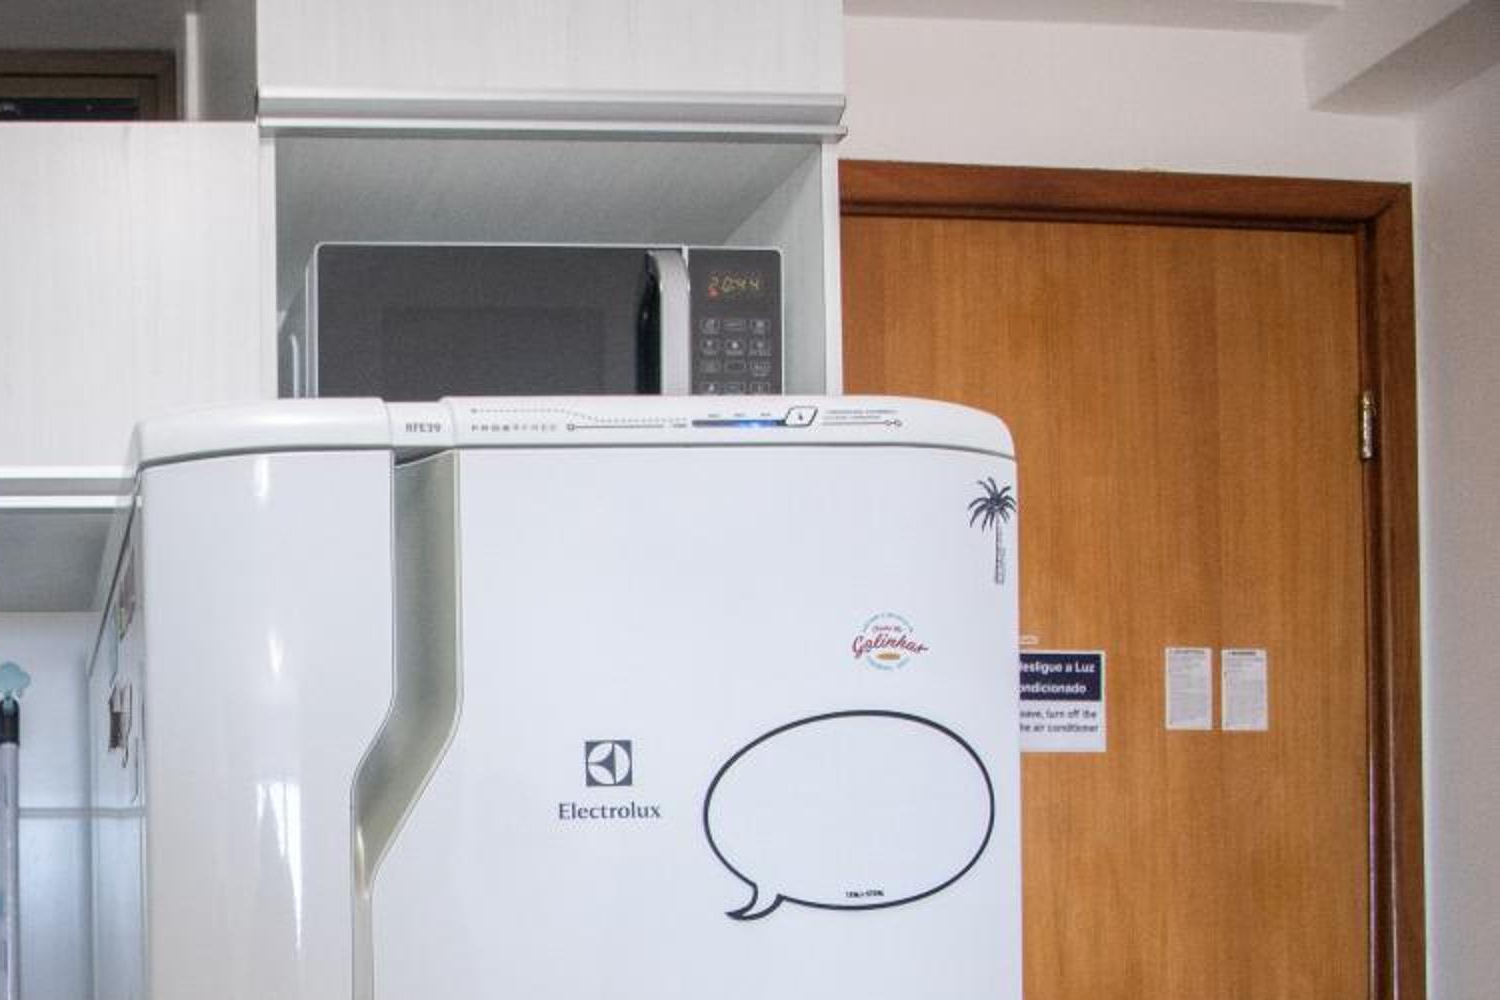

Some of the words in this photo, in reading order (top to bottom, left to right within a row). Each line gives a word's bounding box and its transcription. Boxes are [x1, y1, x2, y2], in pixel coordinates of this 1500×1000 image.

[1019, 661, 1062, 675] esligue
[1075, 661, 1096, 673] Luz
[1019, 683, 1087, 694] ondicionado
[559, 801, 661, 820] Electrolux
